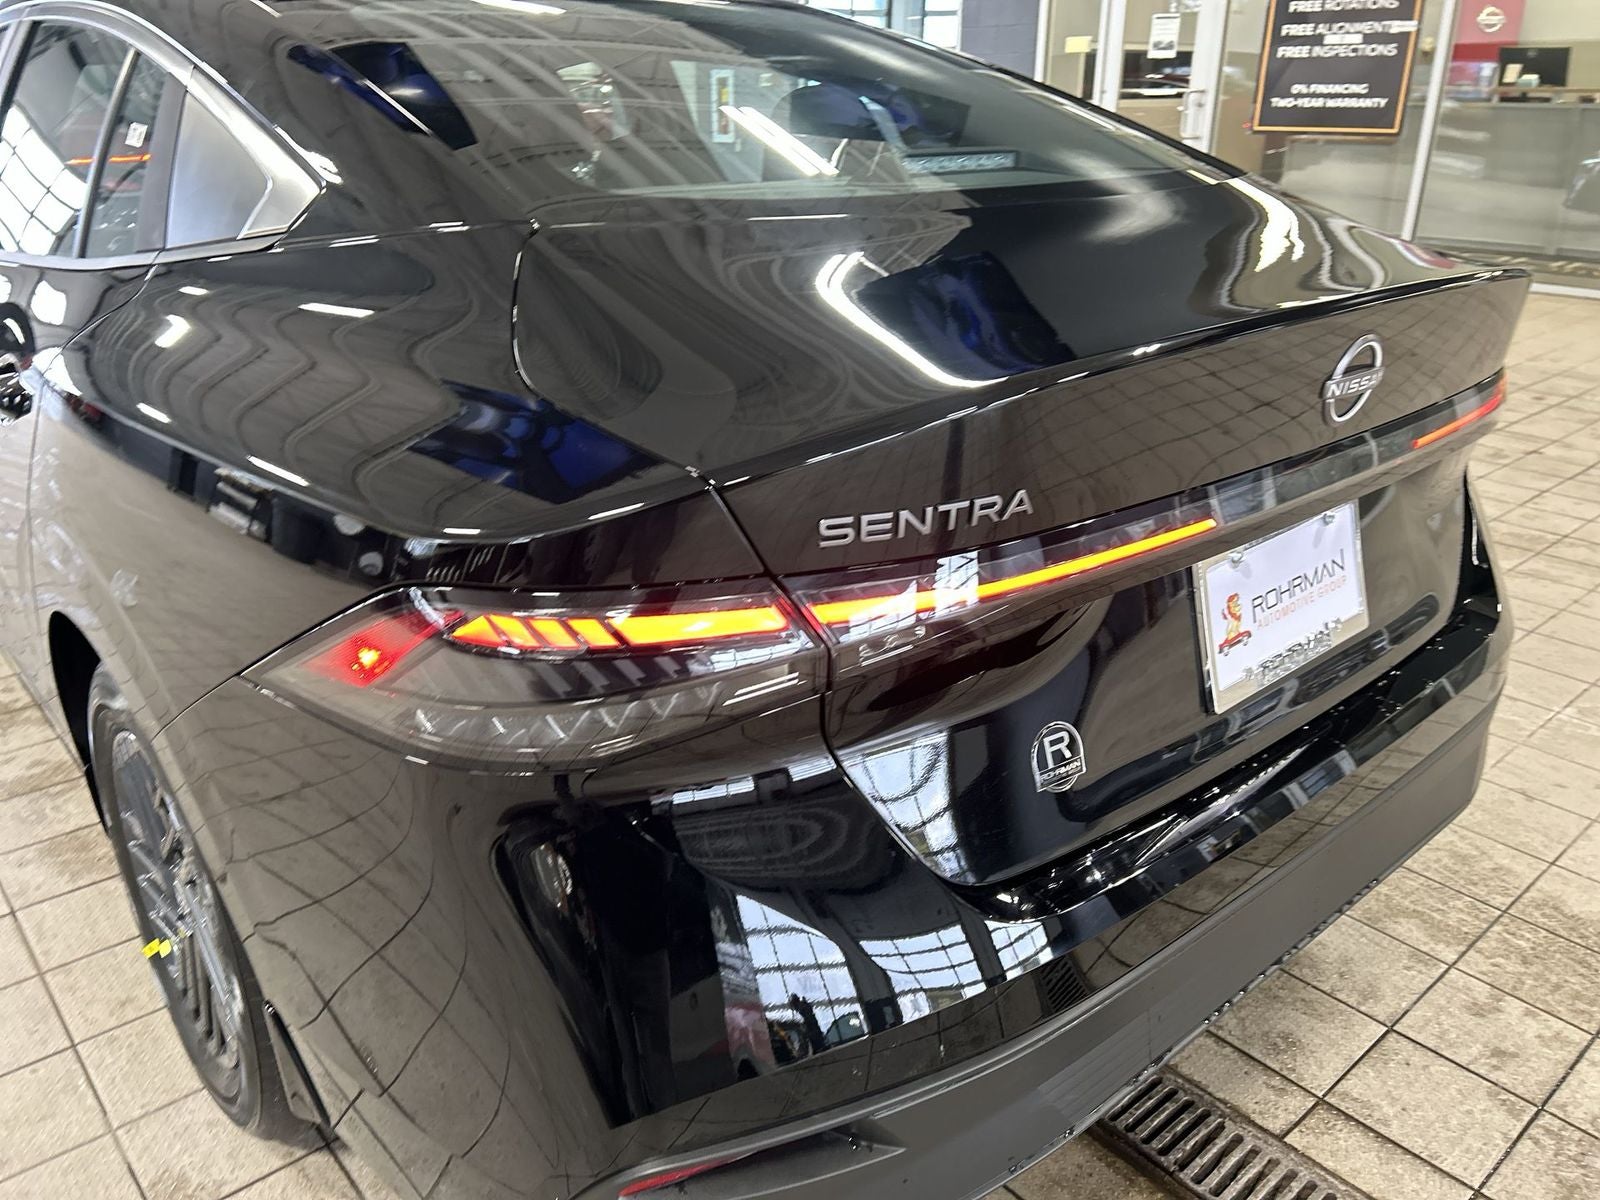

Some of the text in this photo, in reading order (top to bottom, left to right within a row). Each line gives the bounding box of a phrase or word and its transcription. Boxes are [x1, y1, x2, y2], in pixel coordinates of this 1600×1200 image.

[1288, 0, 1400, 12] FREE ROTATIONS
[1281, 24, 1315, 36] FREE
[1276, 43, 1399, 58] FREE INSPECTIONS
[1309, 83, 1370, 94] FINANCING
[1270, 97, 1389, 108] TWO-YEAR WARRANTY
[818, 488, 1034, 548] SENTRA
[1251, 548, 1346, 624] ROHRMAN
[1256, 575, 1347, 629] AUTOMOTIVE GROUP
[1043, 731, 1072, 768] R
